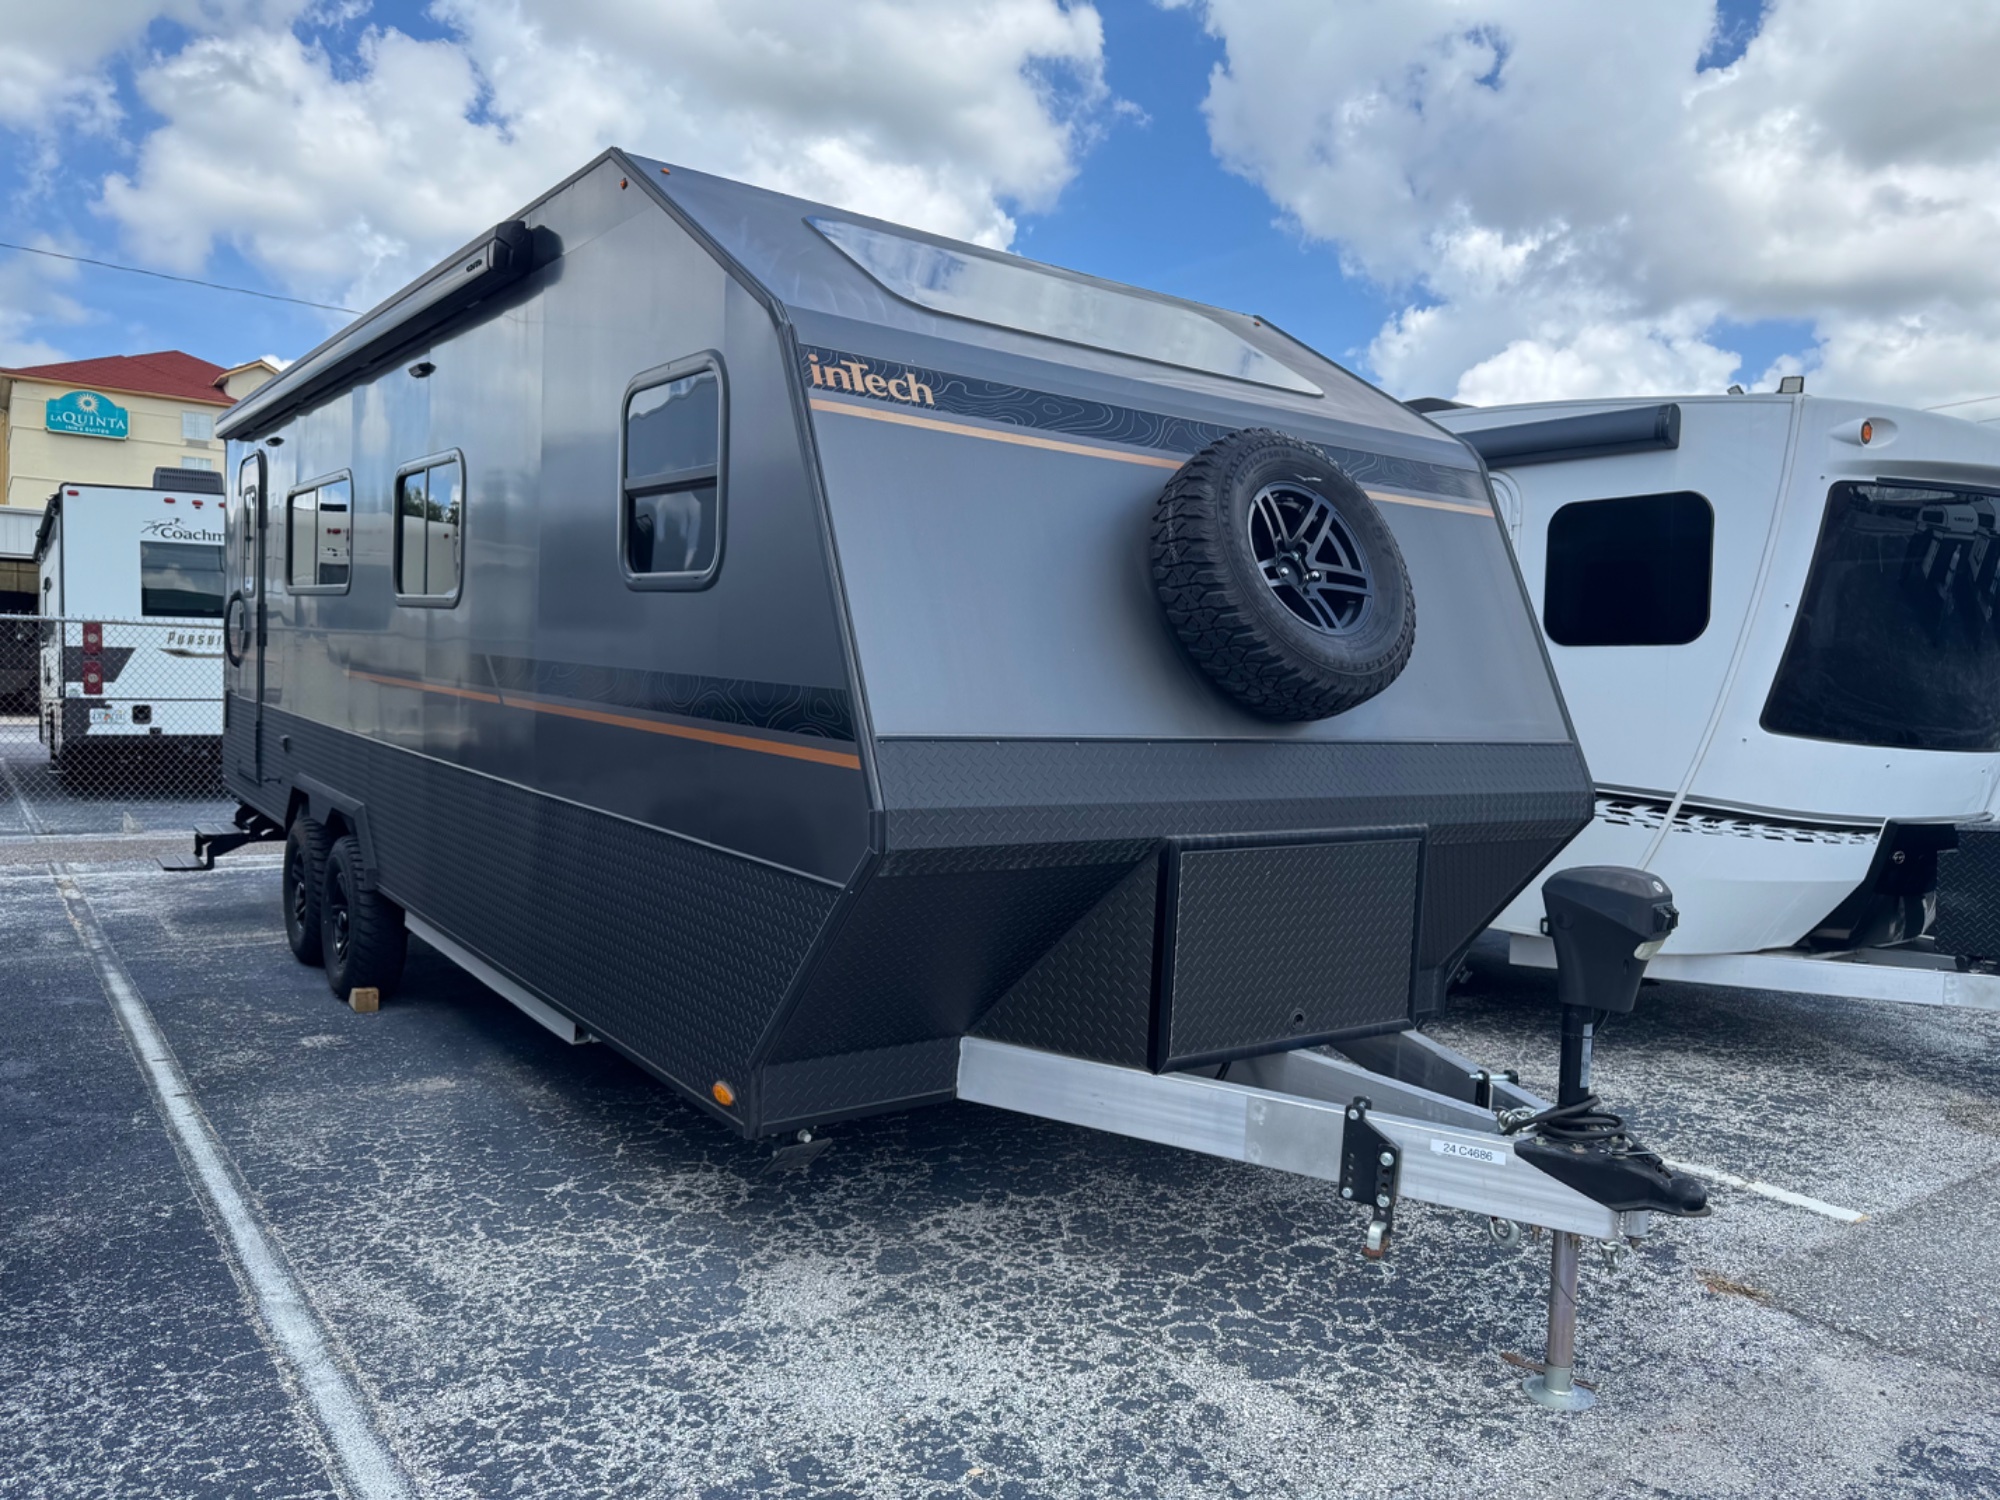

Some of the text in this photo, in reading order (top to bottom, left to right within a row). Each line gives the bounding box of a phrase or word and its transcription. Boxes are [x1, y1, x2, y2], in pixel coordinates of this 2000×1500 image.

[808, 353, 935, 405] inTech
[62, 411, 126, 430] QUINTA
[1443, 1143, 1493, 1162] 24 C4686
